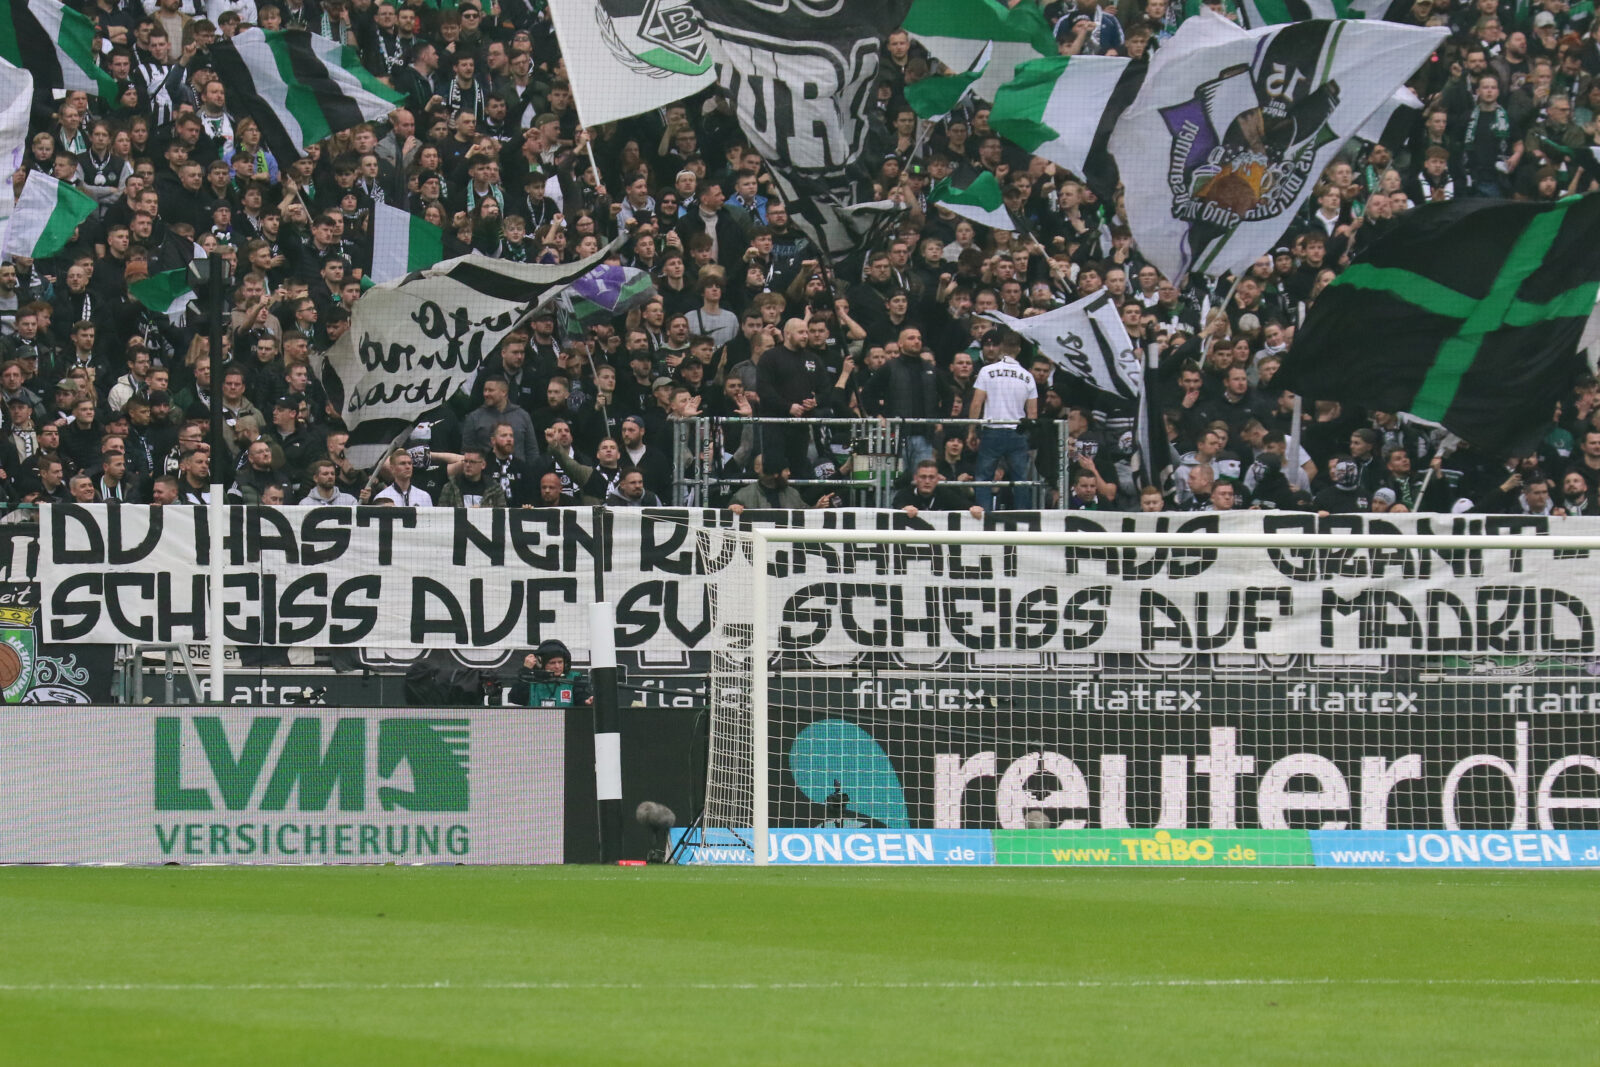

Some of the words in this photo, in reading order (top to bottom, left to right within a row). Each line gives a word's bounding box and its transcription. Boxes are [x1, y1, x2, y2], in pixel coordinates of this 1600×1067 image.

[988, 369, 1031, 384] ULTRAS
[52, 503, 163, 565] DU
[194, 505, 417, 566] HAST
[453, 507, 614, 572] NEN
[51, 571, 381, 645] SCHEISS
[411, 577, 577, 646] AUF
[777, 582, 1111, 650] SCHEISS
[1140, 585, 1295, 650] AUF
[1320, 585, 1595, 653] MADRID
[155, 717, 366, 811] LVM
[155, 824, 470, 856] VERSICHERUNG
[944, 846, 975, 861] .de
[1052, 848, 1117, 861] www.
[1223, 844, 1257, 861] .de
[1331, 850, 1390, 863] www.
[1397, 834, 1572, 863] JONGEN
